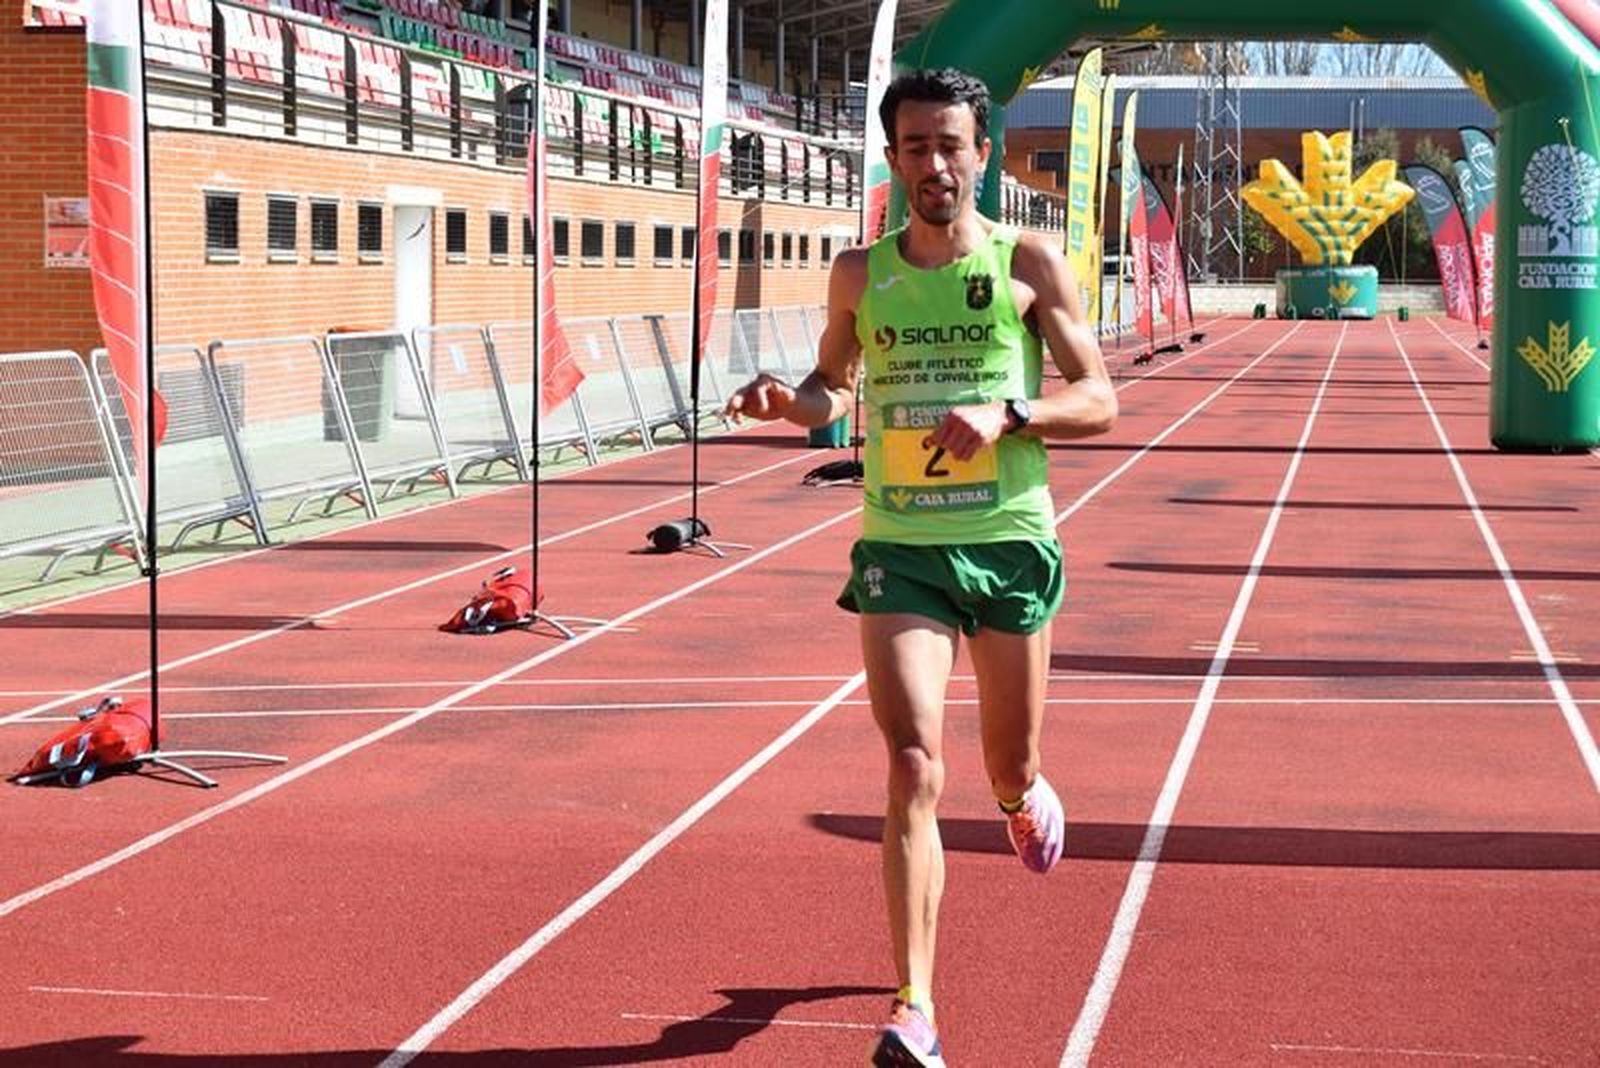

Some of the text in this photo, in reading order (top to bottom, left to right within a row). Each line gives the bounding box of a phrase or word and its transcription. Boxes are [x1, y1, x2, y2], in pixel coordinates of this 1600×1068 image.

[1519, 276, 1598, 288] CAJA RURAL
[887, 356, 985, 371] CLUBE ATLÉTICO
[914, 373, 929, 384] DE
[921, 434, 950, 478] 2
[915, 489, 993, 506] CAJA RURAL
